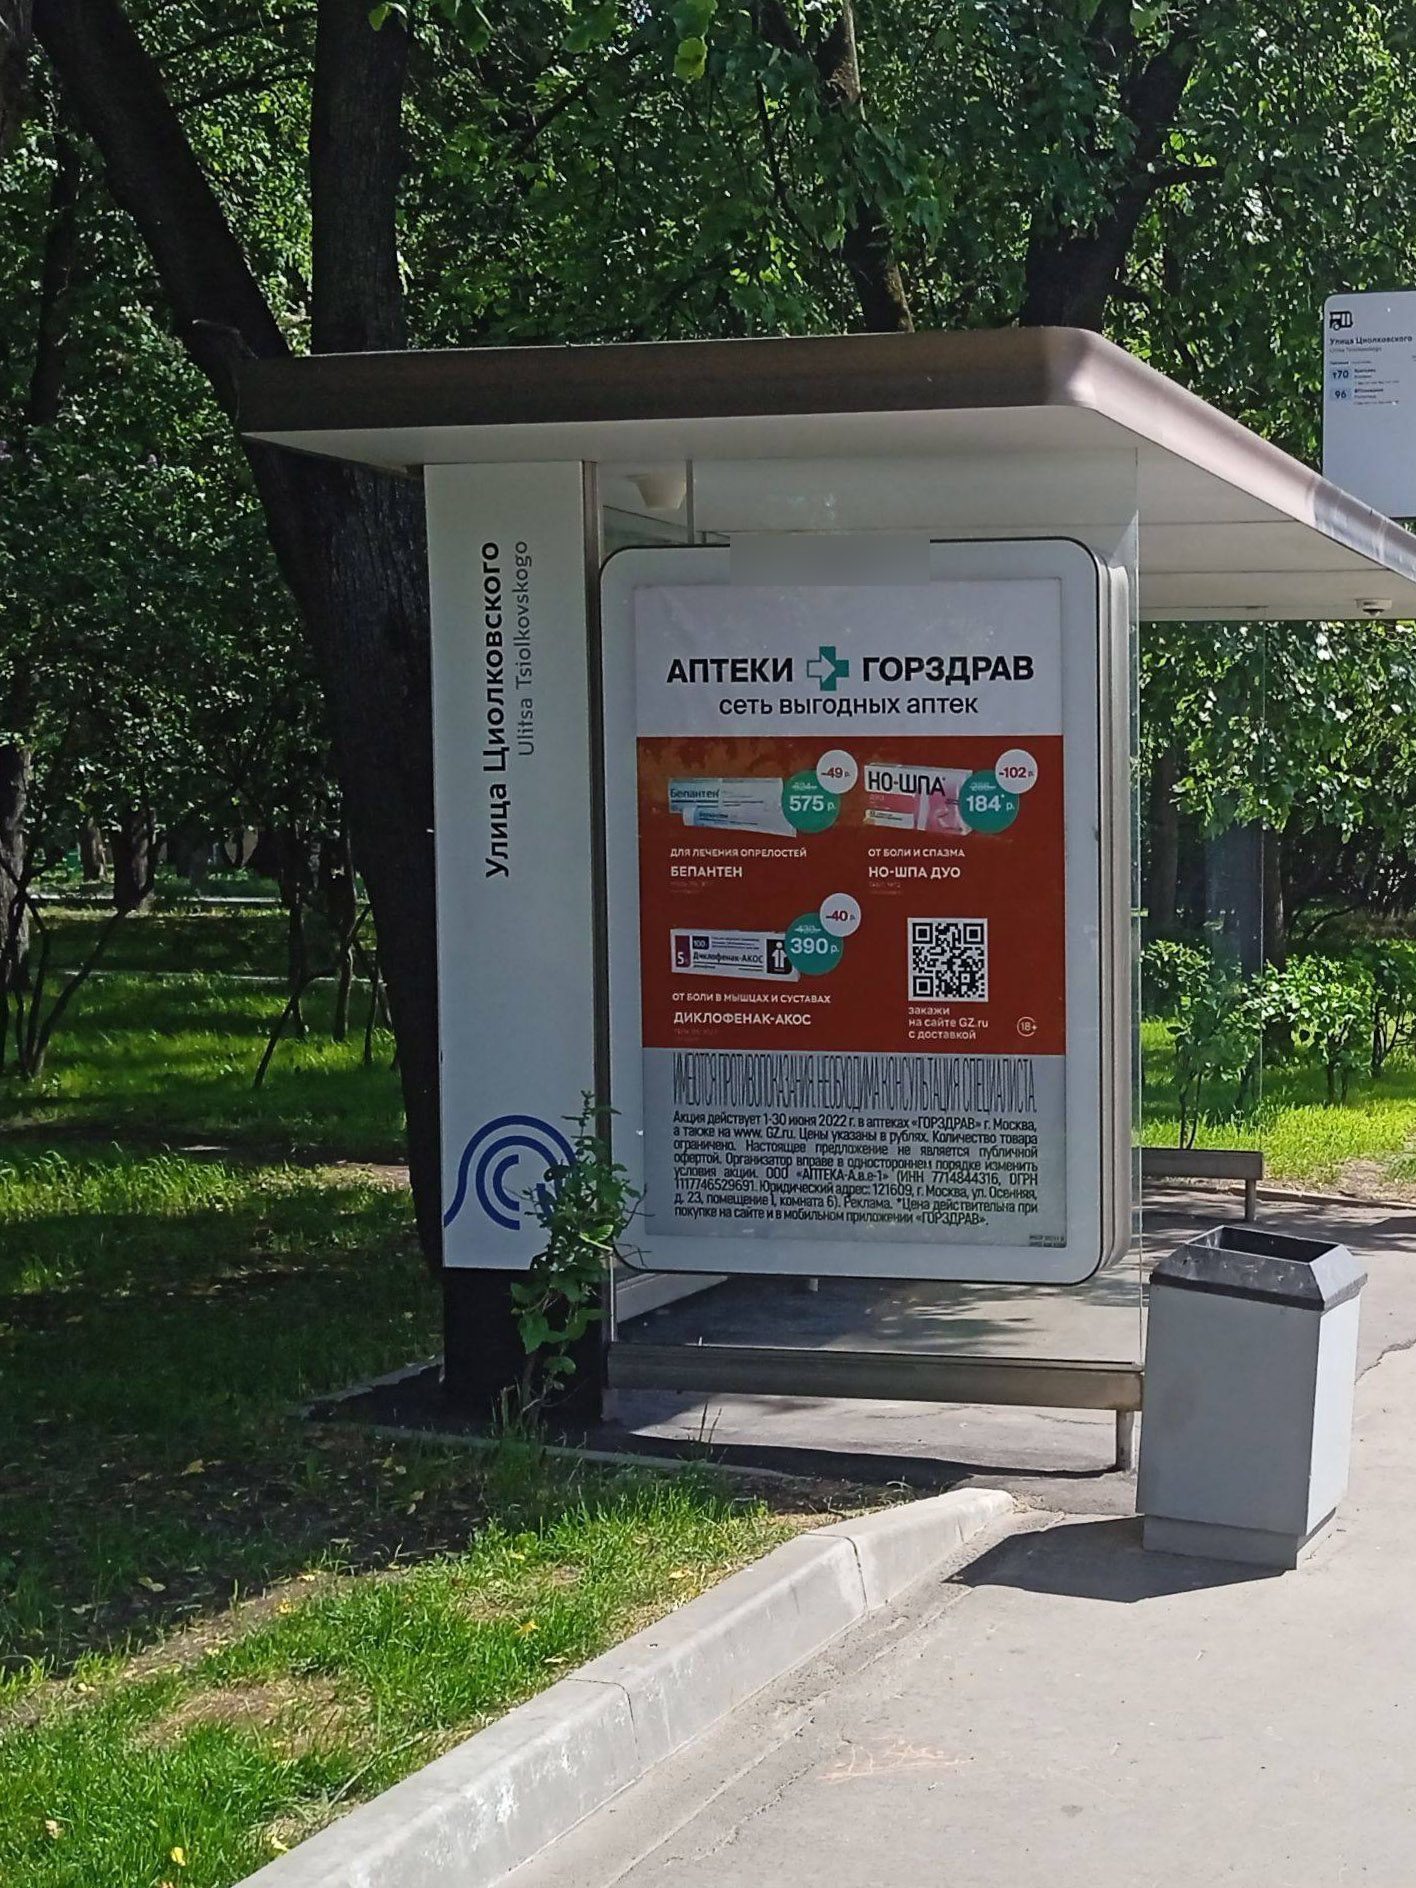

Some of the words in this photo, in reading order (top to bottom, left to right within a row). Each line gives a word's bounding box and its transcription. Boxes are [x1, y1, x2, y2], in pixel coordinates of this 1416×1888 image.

[1356, 336, 1412, 344] Циолковского
[1335, 390, 1346, 398] 96
[512, 541, 532, 690] Tsiolkovskogo
[482, 542, 510, 772] Циолковского
[666, 657, 794, 684] АПТЕКИ
[862, 655, 1034, 685] ГОРЗДРАВ
[719, 698, 773, 715] сеть
[779, 697, 900, 716] выгодных
[906, 696, 978, 716] аптек
[518, 698, 535, 756] Ulitsa
[868, 771, 946, 796] НО-ШПА
[789, 795, 824, 812] 575
[485, 783, 510, 878] Улица
[670, 848, 690, 857] ДЛЯ
[692, 848, 738, 857] ЛЕЧЕНИЯ
[740, 847, 807, 858] ОПРЕЛОСТЕЙ
[868, 849, 882, 857] ОТ
[883, 849, 911, 857] БОЛИ
[912, 849, 921, 857] И
[923, 849, 965, 857] СПАЗМА
[670, 866, 742, 878] БЕПАНТЕН
[868, 867, 928, 878] НО-ШПА
[931, 867, 961, 879] ДУО
[790, 937, 828, 954] 390
[672, 993, 685, 1001] ОТ
[687, 993, 714, 1002] БОЛИ
[716, 994, 722, 1002] В
[724, 994, 768, 1004] МЫШЦАХ
[771, 995, 778, 1003] И
[781, 994, 831, 1004] СУСТАВАХ
[674, 1012, 811, 1025] ДИКЛОФЕНАК-АКОС
[908, 1007, 950, 1015] закажи
[909, 1019, 922, 1027] на
[924, 1017, 956, 1027] сайте
[1021, 1022, 1037, 1031] 18+
[909, 1031, 915, 1039] с
[917, 1030, 976, 1040] доставкой
[673, 1053, 717, 1106] ИМЕЮТСЯ
[673, 1111, 705, 1124] Акция
[707, 1112, 760, 1125] действует
[764, 1113, 786, 1125] 1-30
[789, 1117, 817, 1126] июня
[819, 1115, 846, 1127] 2022
[849, 1119, 856, 1128] г.
[858, 1119, 864, 1128] в
[867, 1118, 909, 1128] аптеках
[912, 1116, 981, 1131] «ГОРЗДРАВ»
[984, 1121, 991, 1130] г.
[993, 1119, 1037, 1132] Москва,
[673, 1128, 680, 1136] а
[683, 1128, 714, 1137] также
[718, 1129, 730, 1137] на
[734, 1129, 762, 1138] www.
[799, 1128, 829, 1141] Цены
[832, 1132, 877, 1143] указаны
[880, 1133, 887, 1141] в
[890, 1130, 929, 1144] рублях.
[933, 1131, 996, 1143] Количество
[1000, 1135, 1037, 1149] товара
[673, 1140, 736, 1154] ограничено.
[746, 1140, 806, 1153] Настоящее
[815, 1144, 889, 1156] предложение
[898, 1146, 911, 1155] не
[920, 1146, 969, 1156] является
[979, 1145, 1037, 1160] публичной
[674, 1151, 722, 1168] офертой.
[725, 1153, 792, 1170] Организатор
[796, 1155, 834, 1169] вправе
[838, 1158, 843, 1167] в
[848, 1158, 931, 1172] одностороннем
[936, 1159, 981, 1173] порядке
[985, 1161, 1038, 1172] изменить
[674, 1167, 716, 1181] условия
[724, 1168, 758, 1180] акции.
[766, 1167, 789, 1179] ООО
[897, 1171, 924, 1184] (ИНН
[932, 1170, 1002, 1186] 7714844316,
[1010, 1173, 1037, 1185] ОГРН
[759, 1180, 833, 1195] Юридический
[835, 1184, 870, 1196] адрес:
[873, 1183, 914, 1197] 121609,
[917, 1186, 925, 1197] г.
[926, 1184, 969, 1198] Москва,
[972, 1188, 986, 1200] ул.
[989, 1187, 1037, 1201] Осенняя,
[674, 1195, 685, 1205] д.
[688, 1193, 704, 1204] 23,
[707, 1193, 768, 1206] помещение
[780, 1196, 824, 1208] комната
[827, 1197, 842, 1209] 6).
[843, 1196, 893, 1209] Реклама.
[933, 1200, 1015, 1214] действительна
[1018, 1202, 1038, 1216] при
[675, 1206, 717, 1219] покупке
[719, 1208, 731, 1218] на
[734, 1206, 764, 1219] сайте
[766, 1209, 773, 1219] и
[775, 1210, 781, 1219] в
[784, 1208, 844, 1220] мобильном
[846, 1212, 913, 1225] приложении
